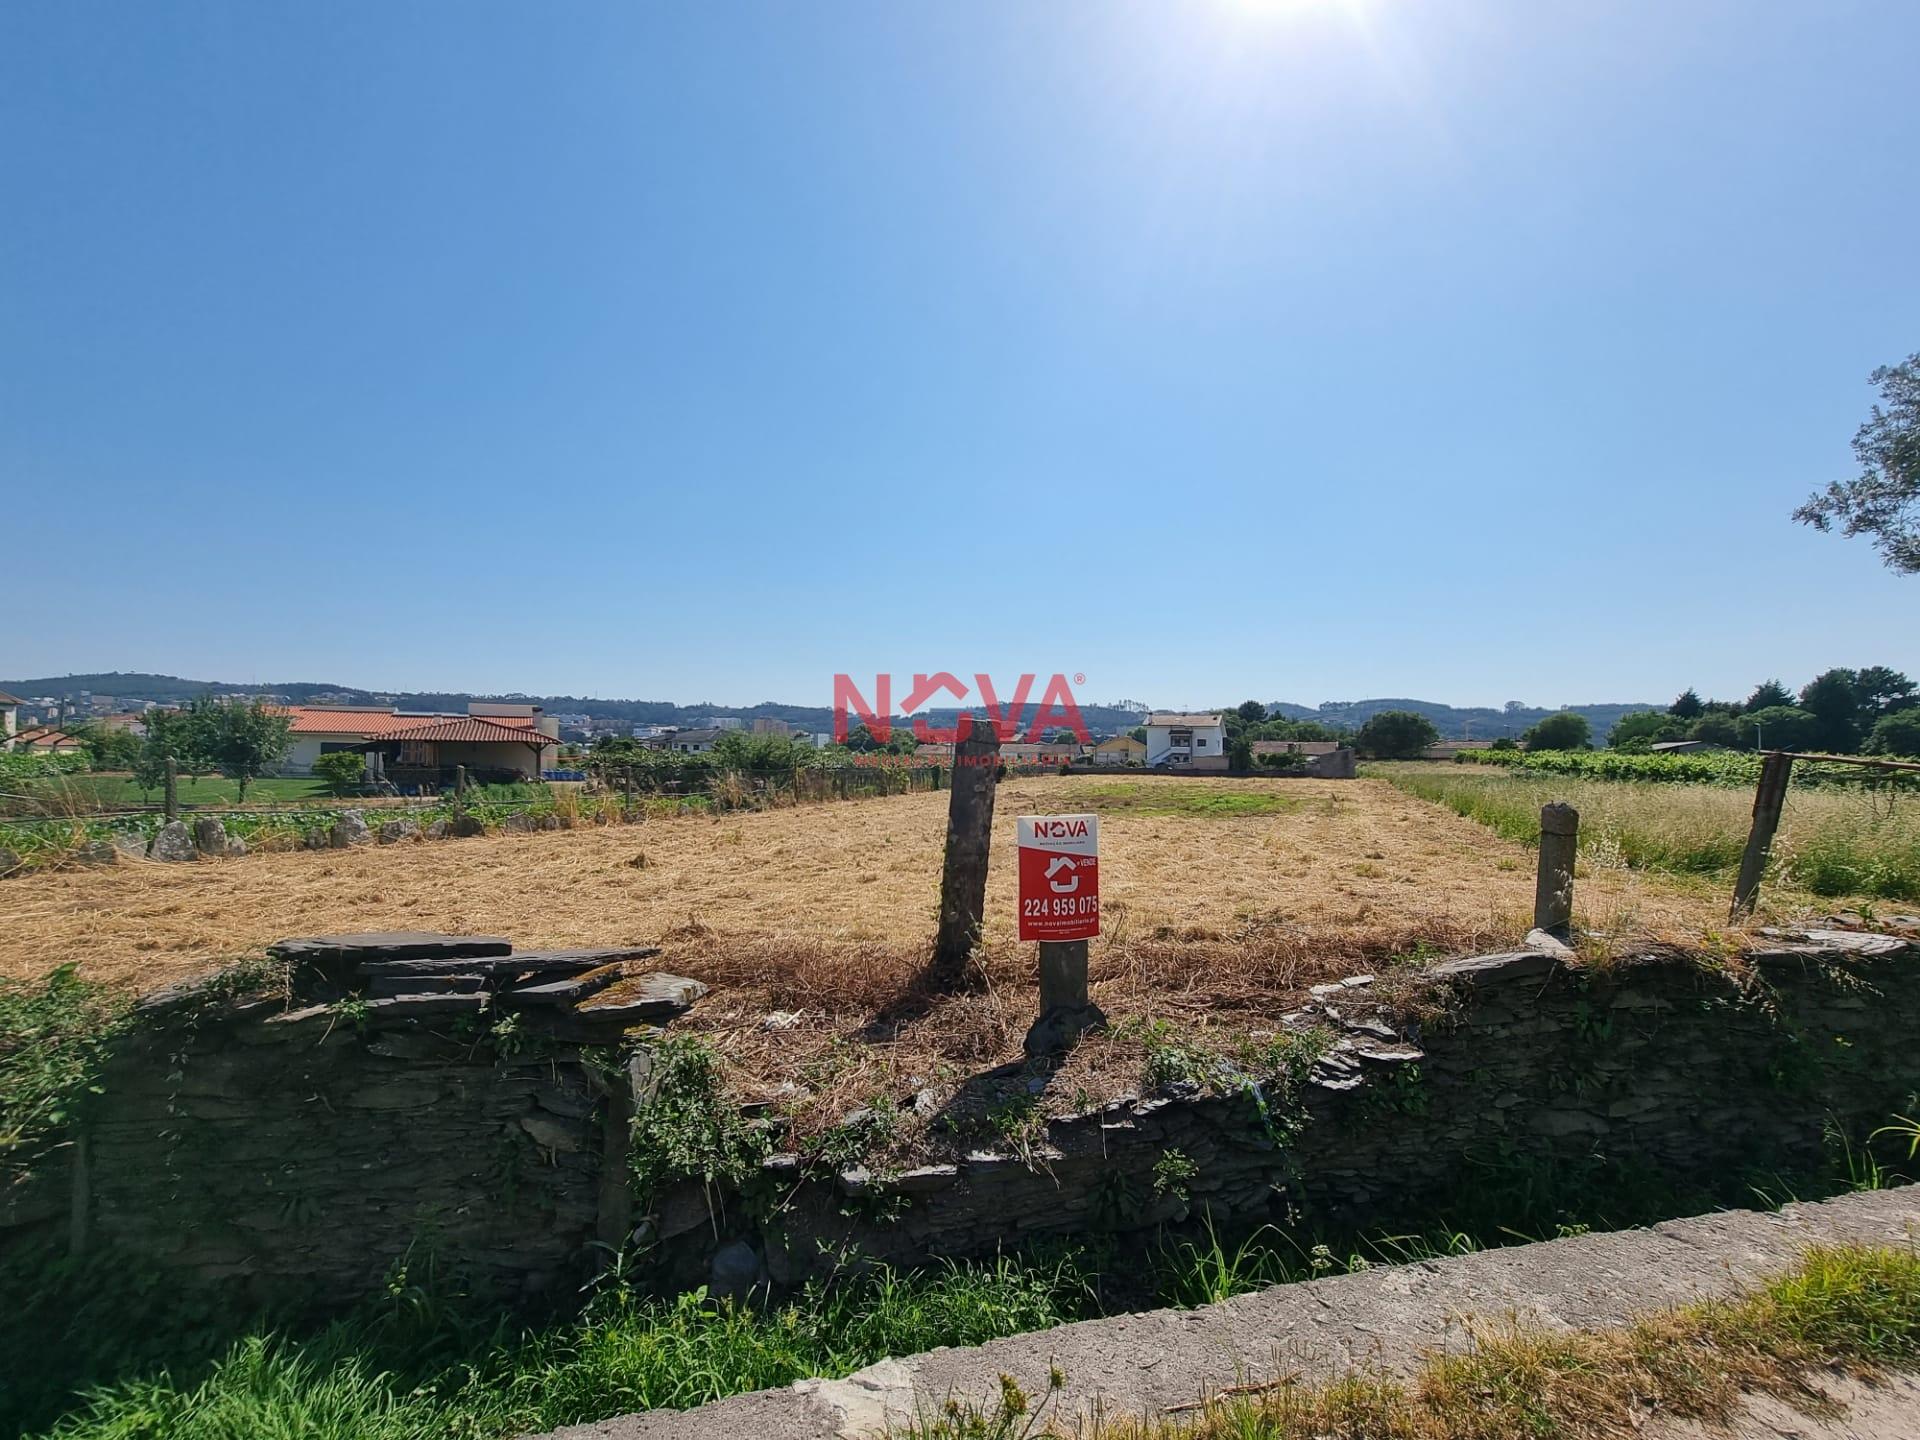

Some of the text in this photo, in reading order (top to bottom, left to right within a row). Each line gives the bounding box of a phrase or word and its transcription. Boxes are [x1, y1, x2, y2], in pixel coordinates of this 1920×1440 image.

[1024, 895, 1098, 916] 224 959 075
